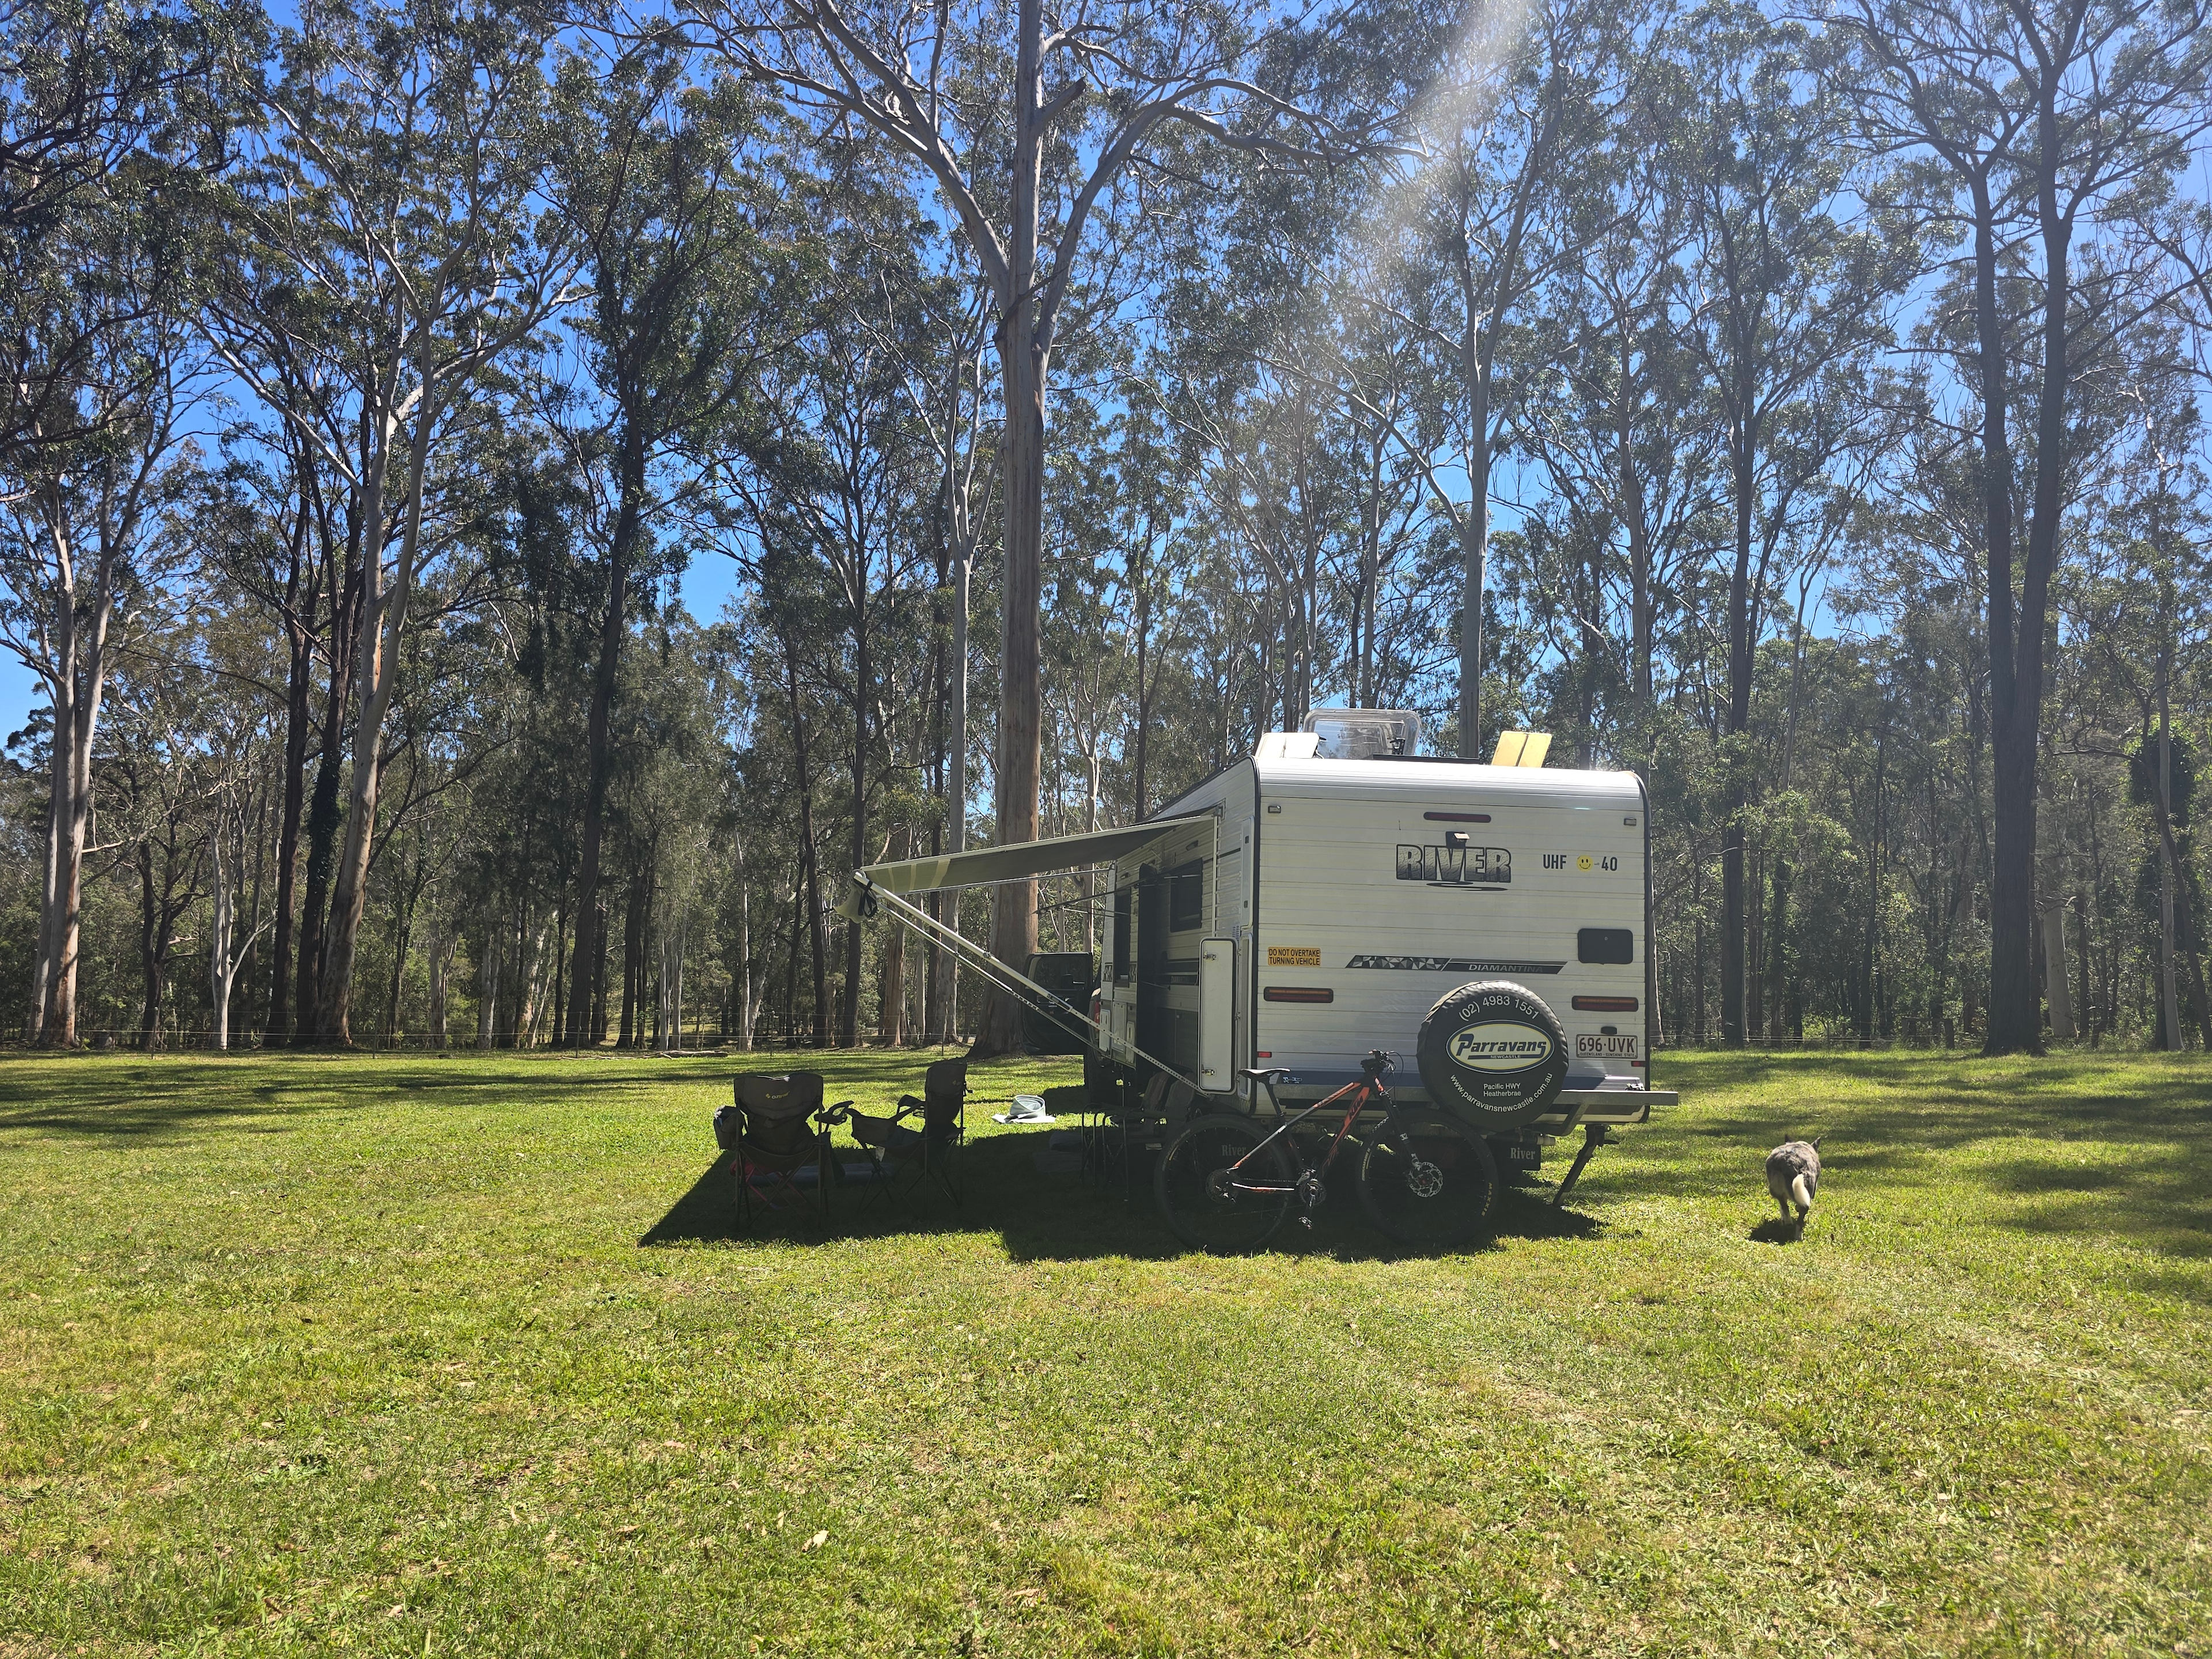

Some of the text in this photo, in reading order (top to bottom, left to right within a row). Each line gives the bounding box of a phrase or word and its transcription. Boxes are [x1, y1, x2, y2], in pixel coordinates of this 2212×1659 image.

[1396, 844, 1512, 884] RIVER
[1543, 854, 1567, 869] UHF
[1469, 964, 1543, 972] DIAMANTINA
[1459, 995, 1539, 1021] (02) 4983 1551
[1456, 1033, 1547, 1059] Parravans
[1450, 1073, 1553, 1112] www.parravansnewcastle.com.au
[1221, 1143, 1247, 1157] River
[1510, 1147, 1536, 1160] River
